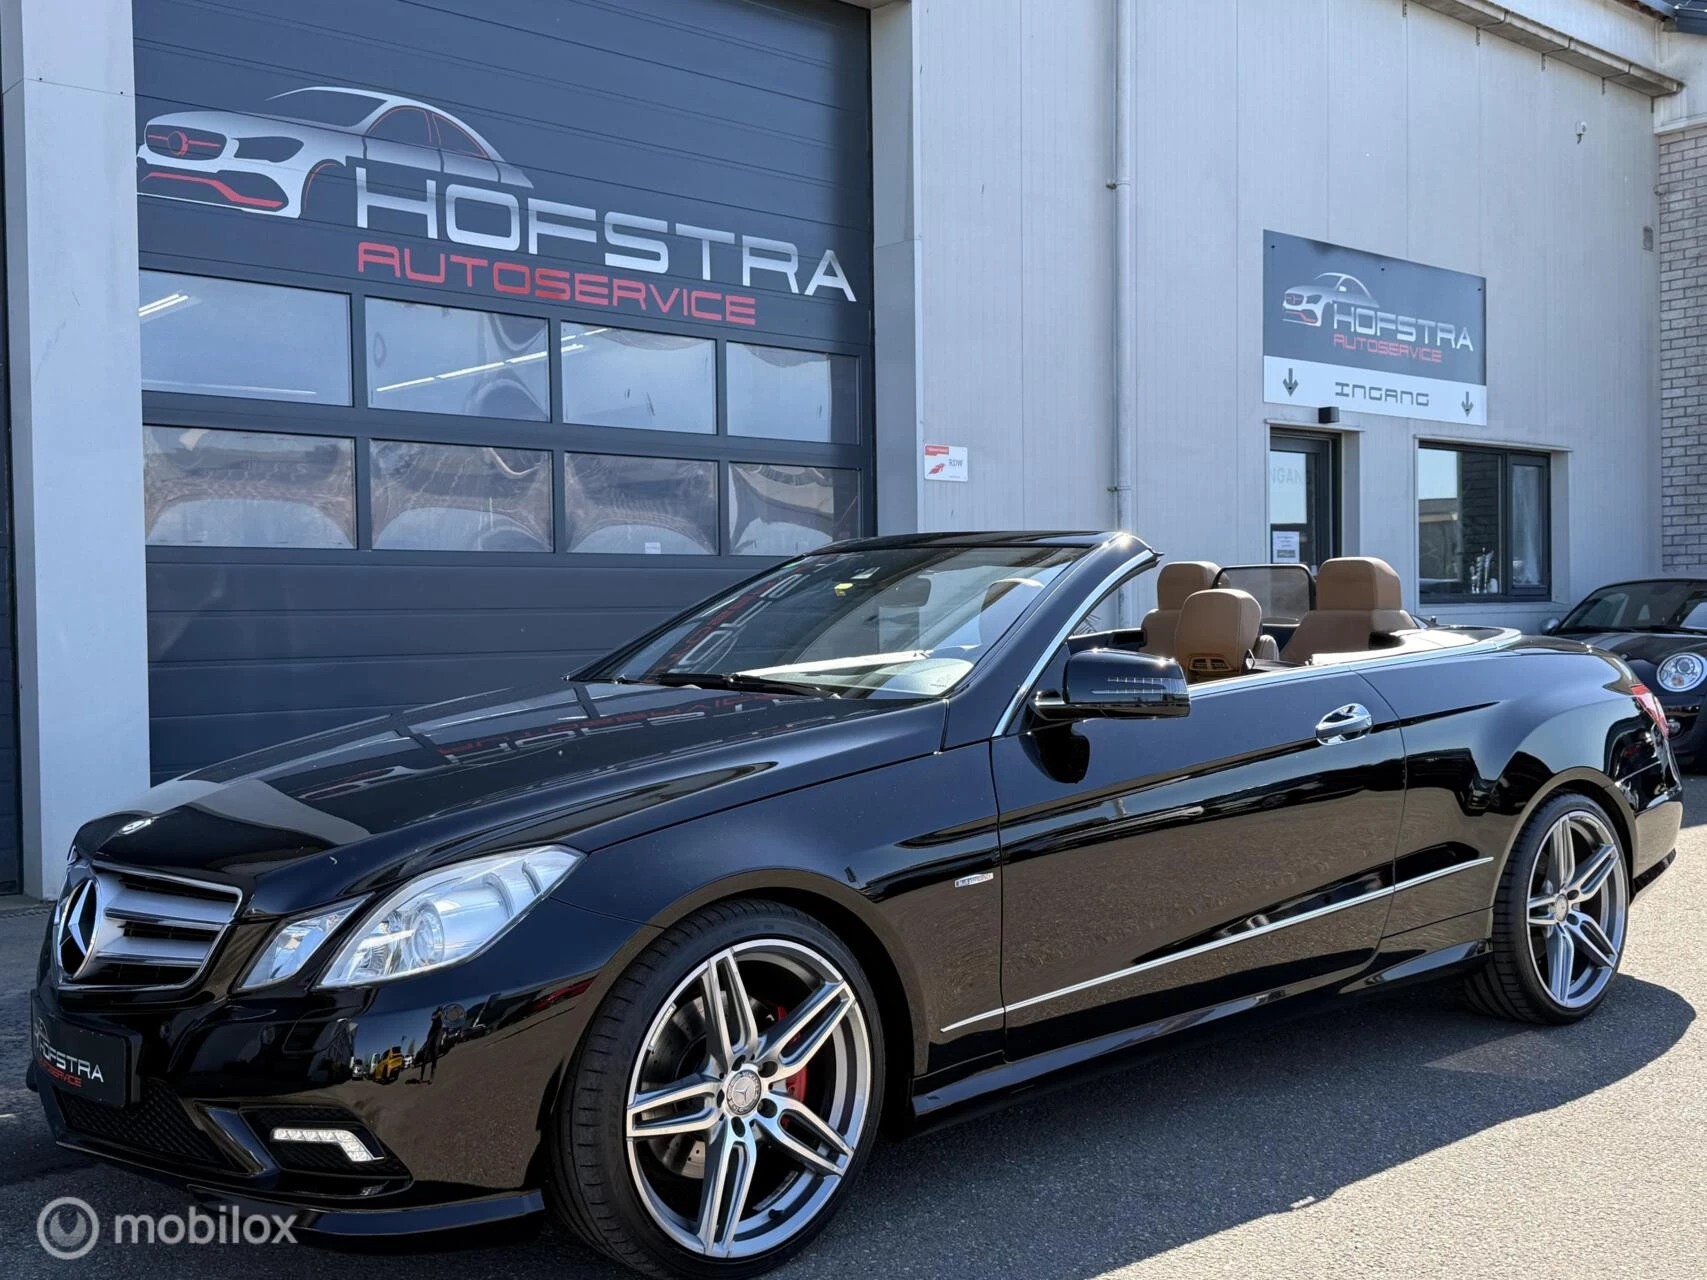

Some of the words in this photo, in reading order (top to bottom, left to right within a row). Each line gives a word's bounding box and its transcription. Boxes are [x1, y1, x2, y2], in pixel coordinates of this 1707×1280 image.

[355, 166, 858, 303] HOFSTRA
[357, 241, 757, 326] AUTOSERVICE
[1333, 303, 1474, 352] HOFSTRA
[1333, 333, 1443, 363] AUTOSERVICE
[1335, 381, 1430, 407] INGANG
[39, 1040, 104, 1083] HOFSTRA
